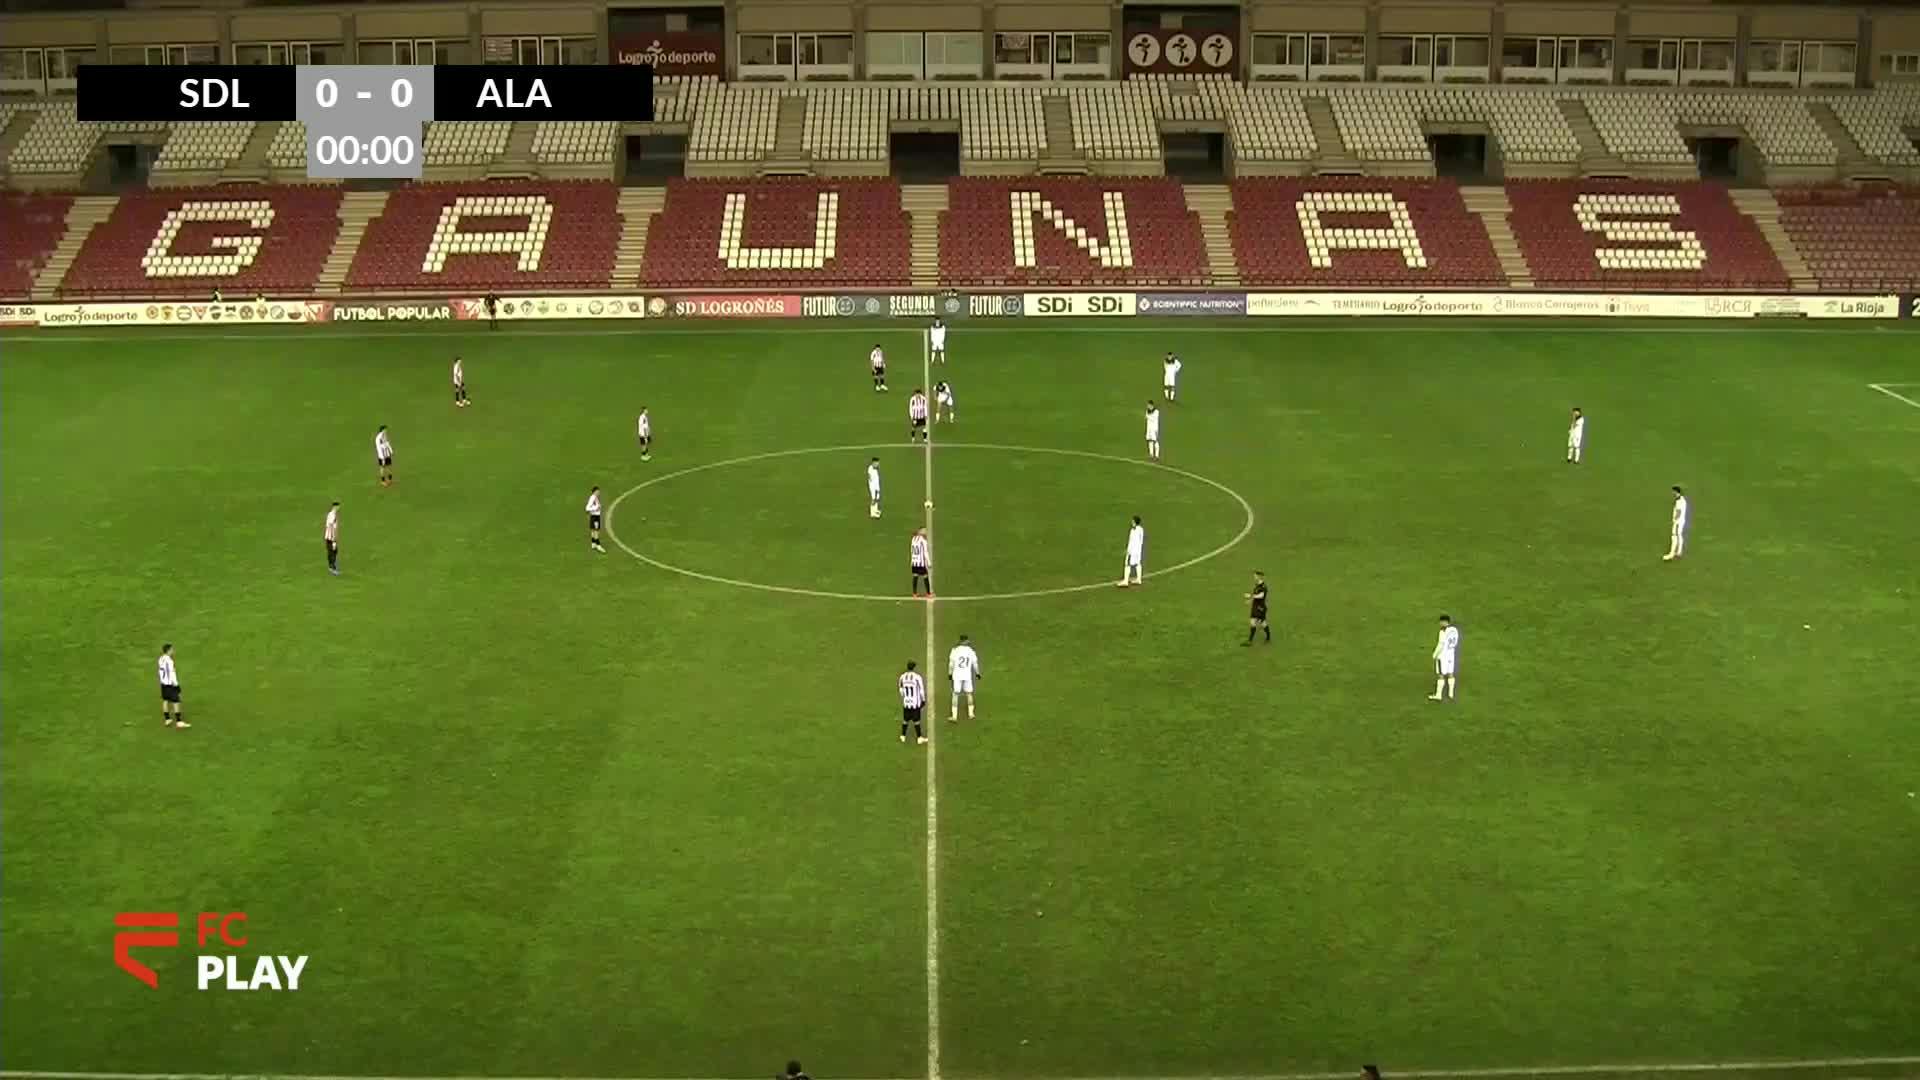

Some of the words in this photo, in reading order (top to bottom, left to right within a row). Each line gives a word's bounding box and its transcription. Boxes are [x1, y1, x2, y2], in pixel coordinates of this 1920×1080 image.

[676, 301, 696, 314] SD
[890, 296, 935, 310] SEGUNDA
[1038, 297, 1072, 312] SDi
[1088, 297, 1122, 312] SDi
[1841, 303, 1853, 313] La
[1856, 302, 1884, 316] Rioja
[388, 306, 449, 319] POPULAR
[905, 686, 914, 697] 11
